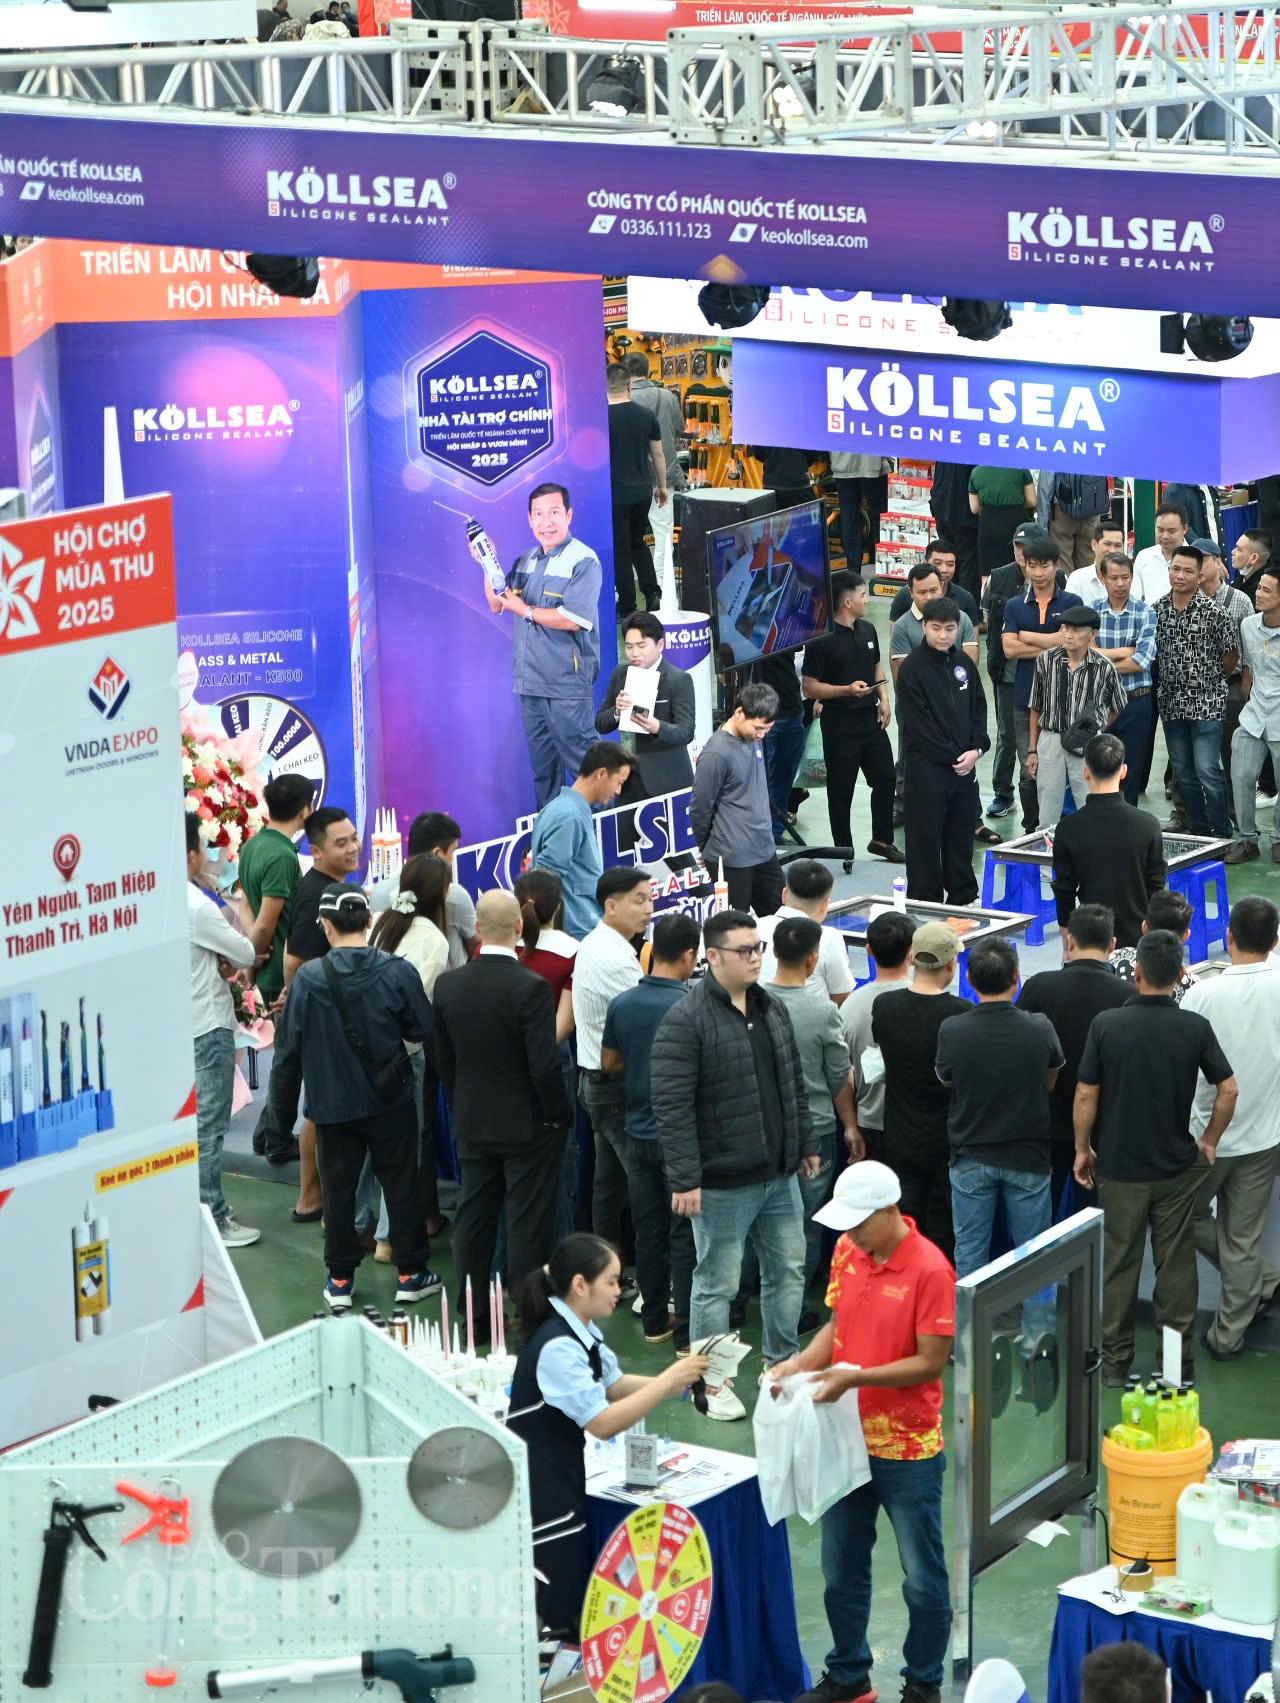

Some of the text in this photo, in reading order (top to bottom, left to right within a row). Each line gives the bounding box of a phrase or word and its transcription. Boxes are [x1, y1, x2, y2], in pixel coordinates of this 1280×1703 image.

[724, 9, 744, 24] LÃM
[17, 158, 143, 182] QUỐC TẾ KOLLSEA
[48, 184, 145, 206] keokollsea.com
[266, 166, 448, 210] KÖLLSEA
[268, 201, 449, 226] SILICONE SEALANT
[587, 189, 632, 210] CÔNG
[633, 194, 654, 211] TY
[727, 197, 774, 218] QUỐC
[776, 199, 795, 220] TẾ
[798, 204, 868, 224] KOLLSEA
[620, 218, 869, 249] 0336.111.123 keokollsea.com
[1008, 207, 1214, 254] KÖLLSEA
[80, 243, 212, 276] TRIỂN LÃM
[1008, 243, 1215, 273] SILICONE SEALANT
[167, 280, 213, 312] HỘI
[765, 297, 918, 332] SILICONE
[429, 373, 538, 395] KÖLLSEA
[826, 362, 1106, 433] KÖLLSEA
[133, 404, 293, 431] KÖLLSEA
[418, 407, 553, 429] NHÀ TÀI TRỢ CHÍNH
[827, 409, 1107, 457] SILICONE SEALANT
[223, 429, 294, 439] SEALANT
[471, 453, 509, 468] 2025
[54, 513, 146, 558] HỘI CHỢ
[55, 552, 155, 594] MÙA THU
[57, 595, 116, 631] 2025
[242, 629, 304, 644] SILICONE
[665, 627, 711, 644] KÖLLS
[198, 652, 284, 667] ASS & METAL
[265, 668, 303, 684] K500
[64, 727, 159, 764] VNDA EXPO
[270, 719, 302, 758] 100.000đ
[303, 752, 319, 765] KEO
[3, 901, 33, 927] Yên
[85, 881, 117, 905] Tam
[121, 870, 157, 897] Hiệp
[5, 925, 56, 959] Thanh
[88, 911, 109, 937] Hà
[113, 903, 139, 932] Nội
